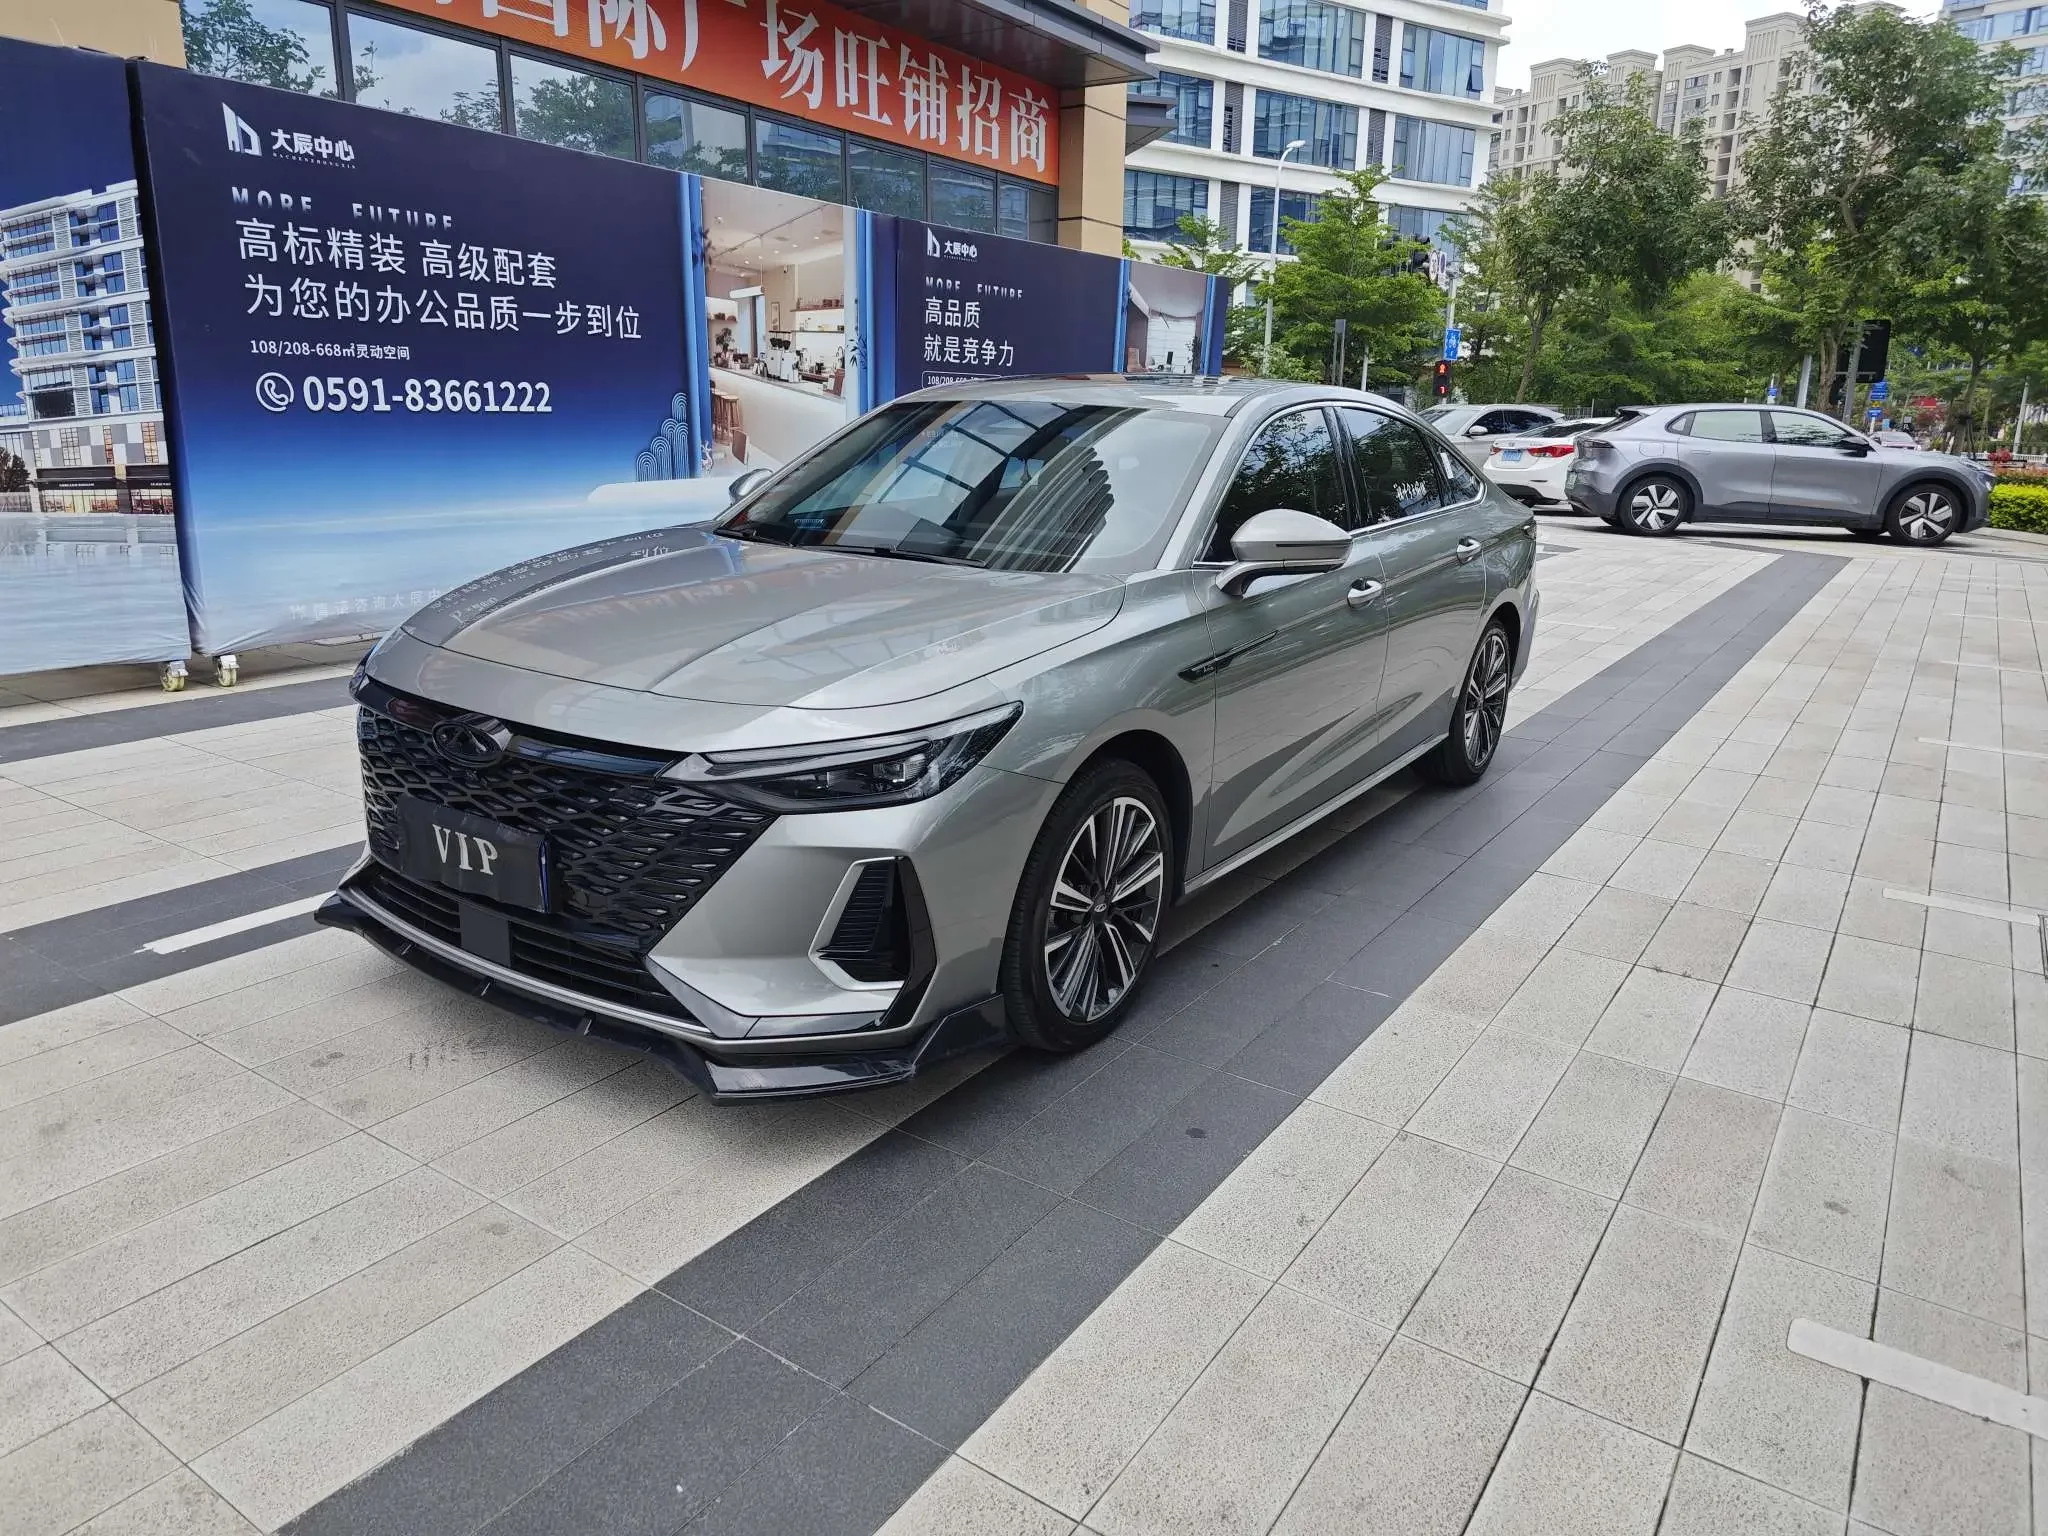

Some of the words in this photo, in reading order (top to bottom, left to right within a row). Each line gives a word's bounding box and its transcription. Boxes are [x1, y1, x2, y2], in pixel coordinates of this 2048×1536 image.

[271, 129, 355, 162] 大辰中心
[231, 186, 312, 213] MORE
[352, 202, 452, 230] FUTURE
[235, 217, 407, 275] 高标精装
[419, 238, 557, 289] 高级配套
[944, 240, 978, 258] 大辰中心
[244, 273, 642, 339] 为您的办公品质一步到位
[925, 296, 981, 329] 高品质
[923, 333, 1014, 367] 就是竞争力
[303, 376, 552, 412] 0591-83661222
[432, 824, 498, 875] VIP
